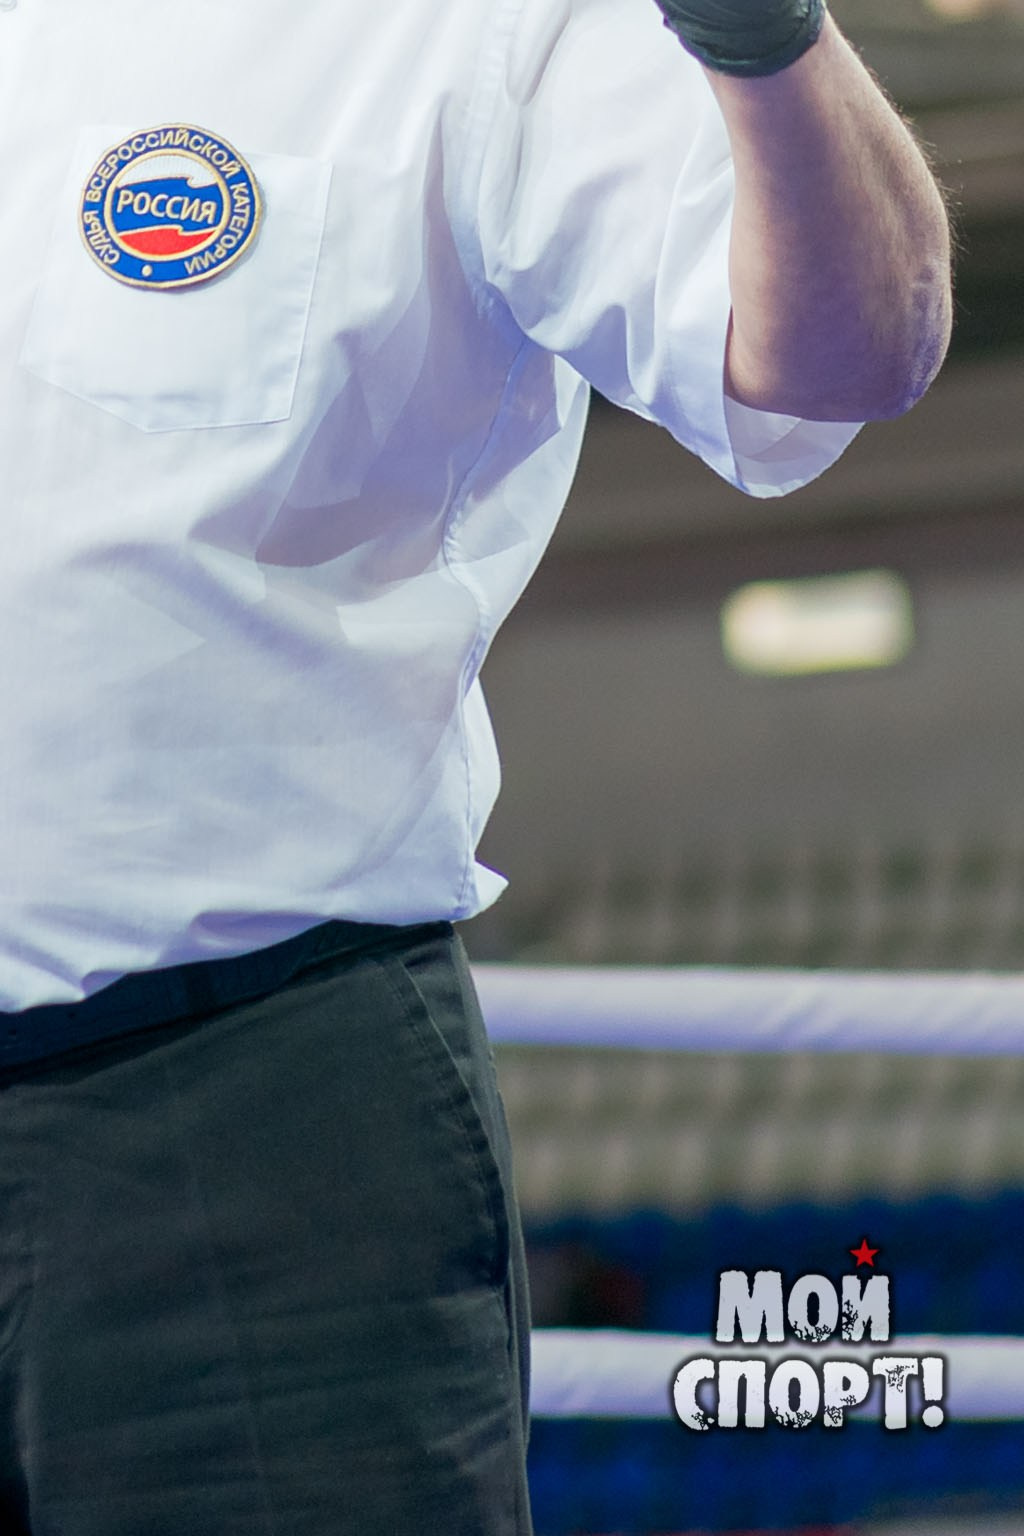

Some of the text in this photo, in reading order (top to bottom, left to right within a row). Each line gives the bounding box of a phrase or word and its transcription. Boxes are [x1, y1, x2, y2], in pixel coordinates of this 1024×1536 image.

[83, 129, 250, 274] СУДЬЯ ВСЕРОССИЙСКОЙ КАТЕГОРИИ
[116, 189, 217, 224] РОССИЯ
